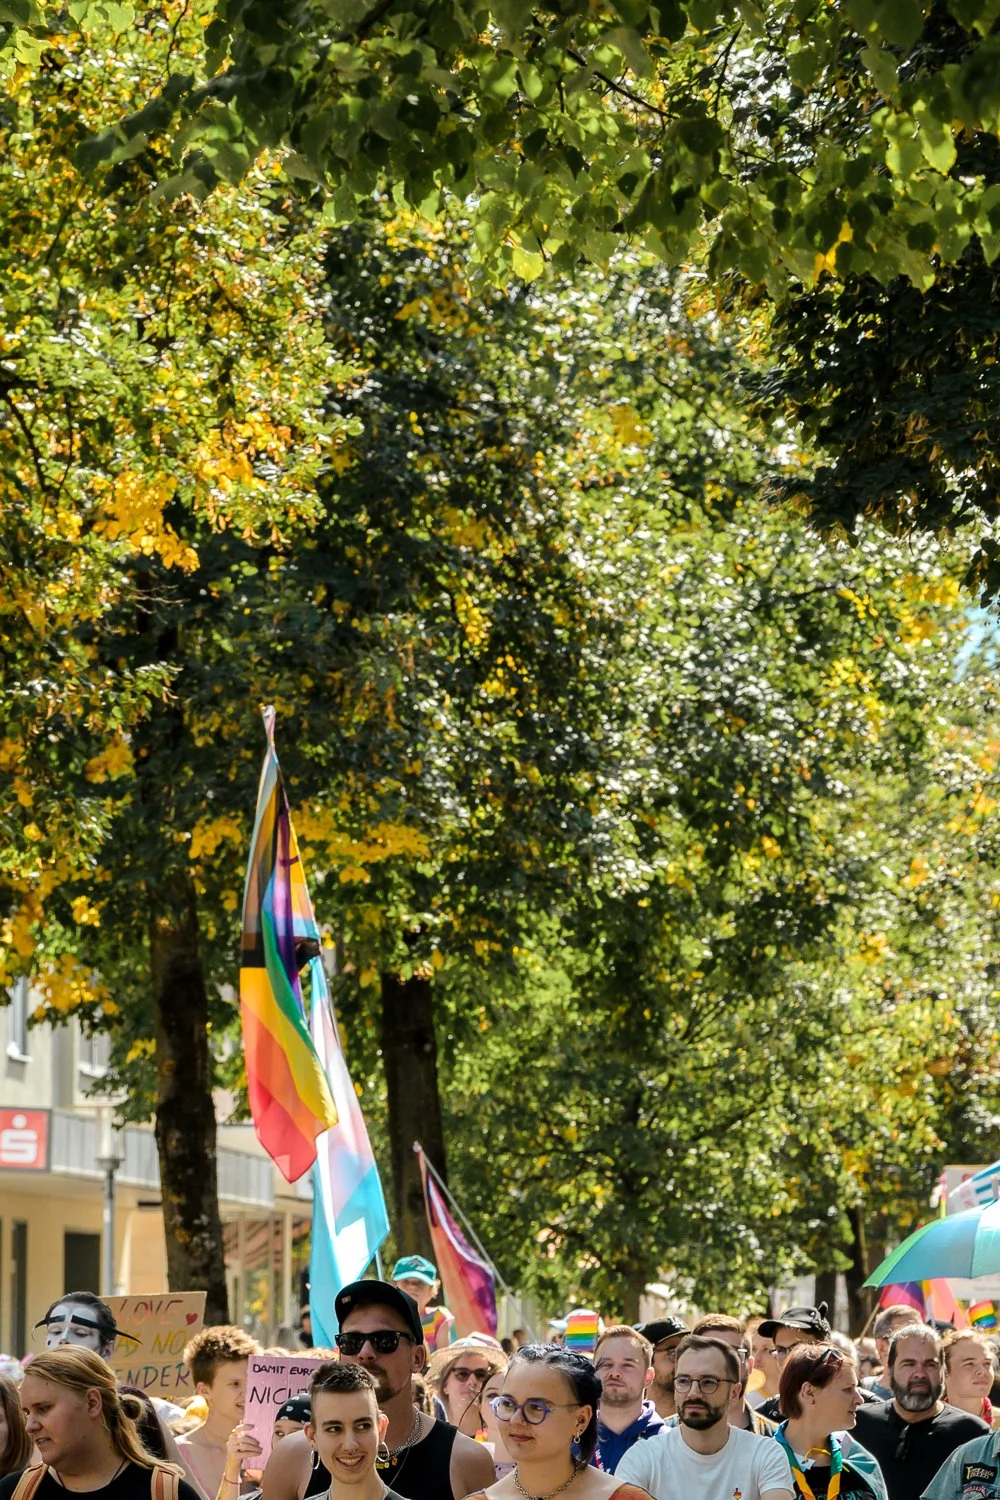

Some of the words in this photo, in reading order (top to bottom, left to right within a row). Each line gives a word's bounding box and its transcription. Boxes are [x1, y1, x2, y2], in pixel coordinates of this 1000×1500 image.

[114, 1298, 184, 1326] LOVE
[151, 1329, 188, 1356] NO
[115, 1361, 190, 1388] ENDER
[253, 1364, 286, 1374] DAMIT
